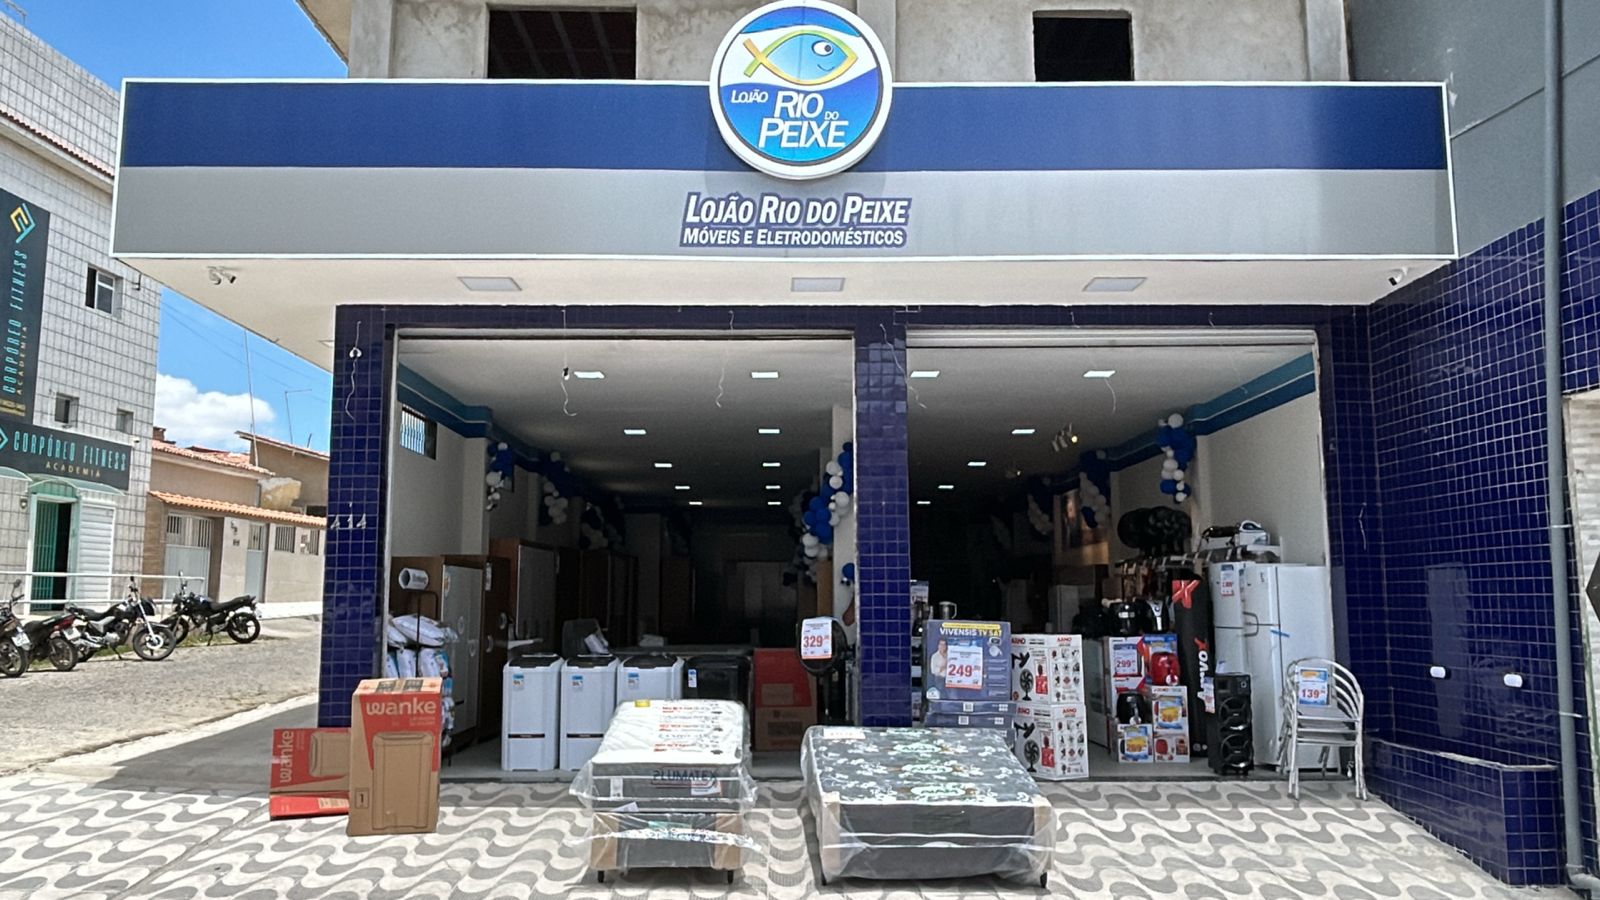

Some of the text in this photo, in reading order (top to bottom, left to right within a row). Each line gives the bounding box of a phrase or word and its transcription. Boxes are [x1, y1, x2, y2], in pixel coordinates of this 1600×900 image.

[731, 90, 769, 103] LOJÃO
[774, 91, 839, 120] RIO DO
[758, 118, 849, 148] PEIXE
[685, 195, 909, 224] LOJÃO RIO DO PEIXE
[683, 227, 904, 245] MÓVEIS E ELETRODOMÉSTICOS
[10, 250, 28, 312] FITNESS
[3, 319, 22, 394] CORPÓREO
[17, 326, 27, 395] ACADEMIA
[13, 431, 127, 471] CORPÓREO FITNESS
[45, 461, 101, 478] ACADEMIA
[803, 635, 823, 648] 329
[940, 628, 977, 636] VIVENSIS
[948, 664, 973, 677] 249
[1302, 689, 1320, 698] 139
[366, 697, 437, 715] wanke
[277, 730, 294, 783] wanke
